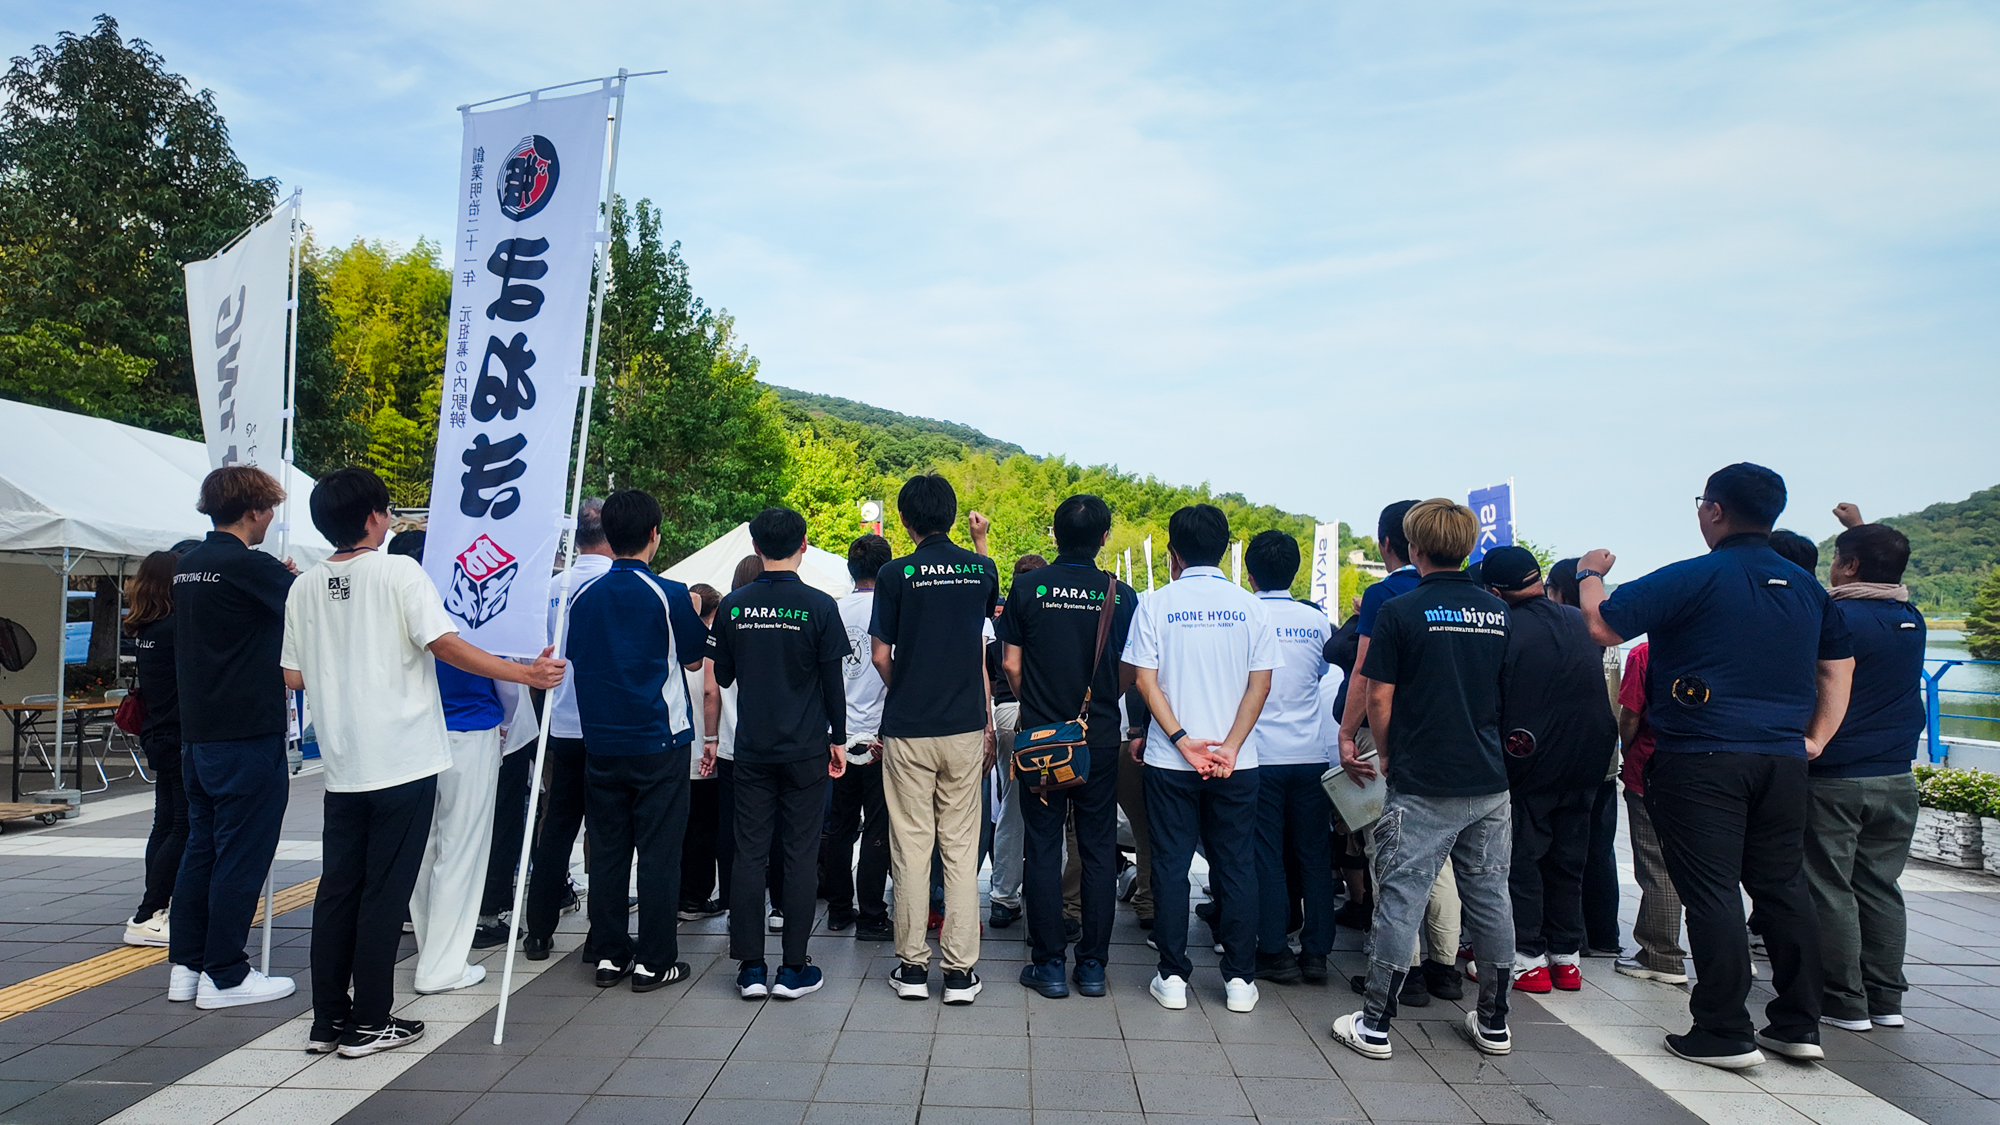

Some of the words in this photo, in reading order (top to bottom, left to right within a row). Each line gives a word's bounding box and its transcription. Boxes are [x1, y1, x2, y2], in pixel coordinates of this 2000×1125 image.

[920, 564, 985, 576] PARASAFE
[202, 571, 221, 583] LLC
[916, 580, 933, 588] Safety
[933, 578, 955, 587] Systems
[1052, 587, 1121, 605] PARASAE
[1045, 602, 1063, 610] Safety
[1063, 602, 1086, 611] Systems
[744, 607, 810, 622] PARASAFE
[1167, 610, 1204, 624] DRONE
[1207, 610, 1247, 622] HYOGO
[1424, 605, 1506, 628] mizubiyori
[738, 623, 754, 632] Safety
[754, 622, 775, 631] Systems
[782, 622, 801, 631] Drones
[1285, 627, 1319, 639] HYOGO
